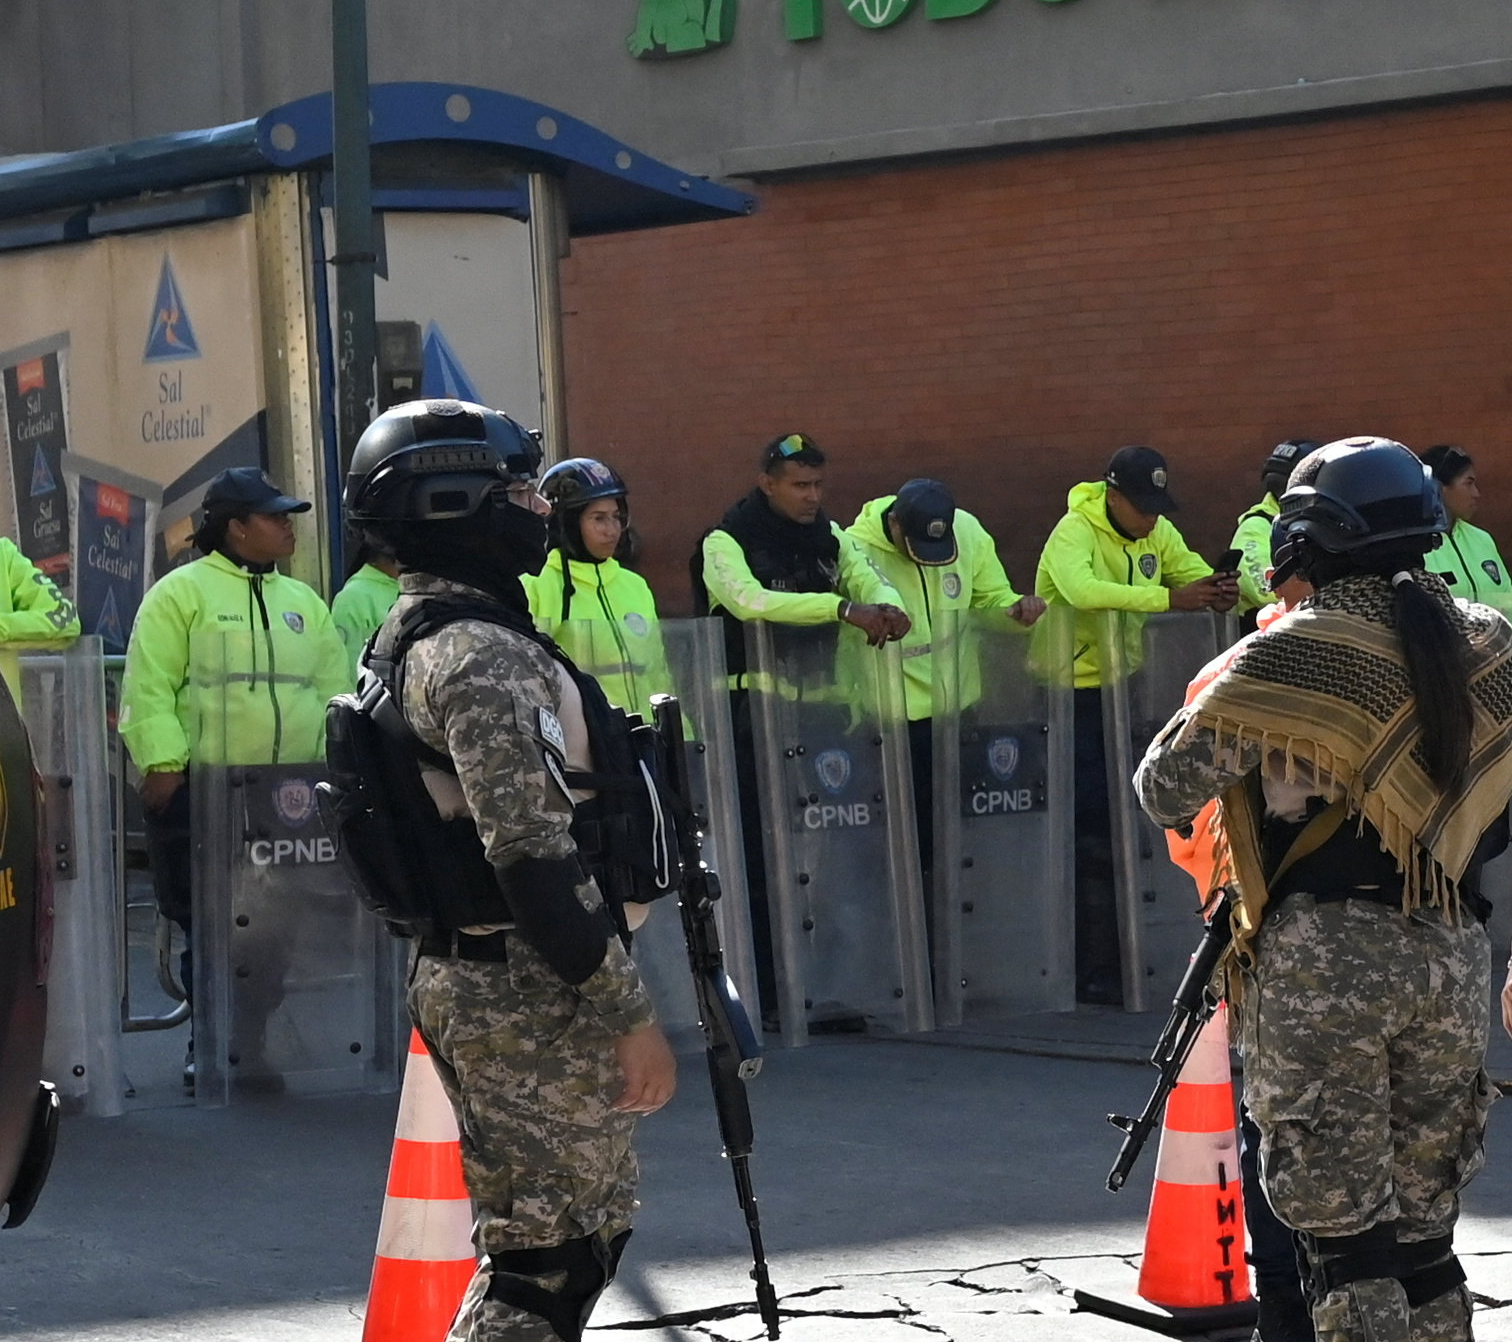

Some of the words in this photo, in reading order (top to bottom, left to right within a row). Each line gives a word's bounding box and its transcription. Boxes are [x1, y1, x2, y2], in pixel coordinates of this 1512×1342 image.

[158, 370, 182, 404] Sal
[26, 393, 42, 417] Sal
[39, 500, 53, 522] Sal
[972, 789, 1033, 815] CPNB
[804, 804, 871, 829] CPNB
[250, 837, 336, 866] CPNB
